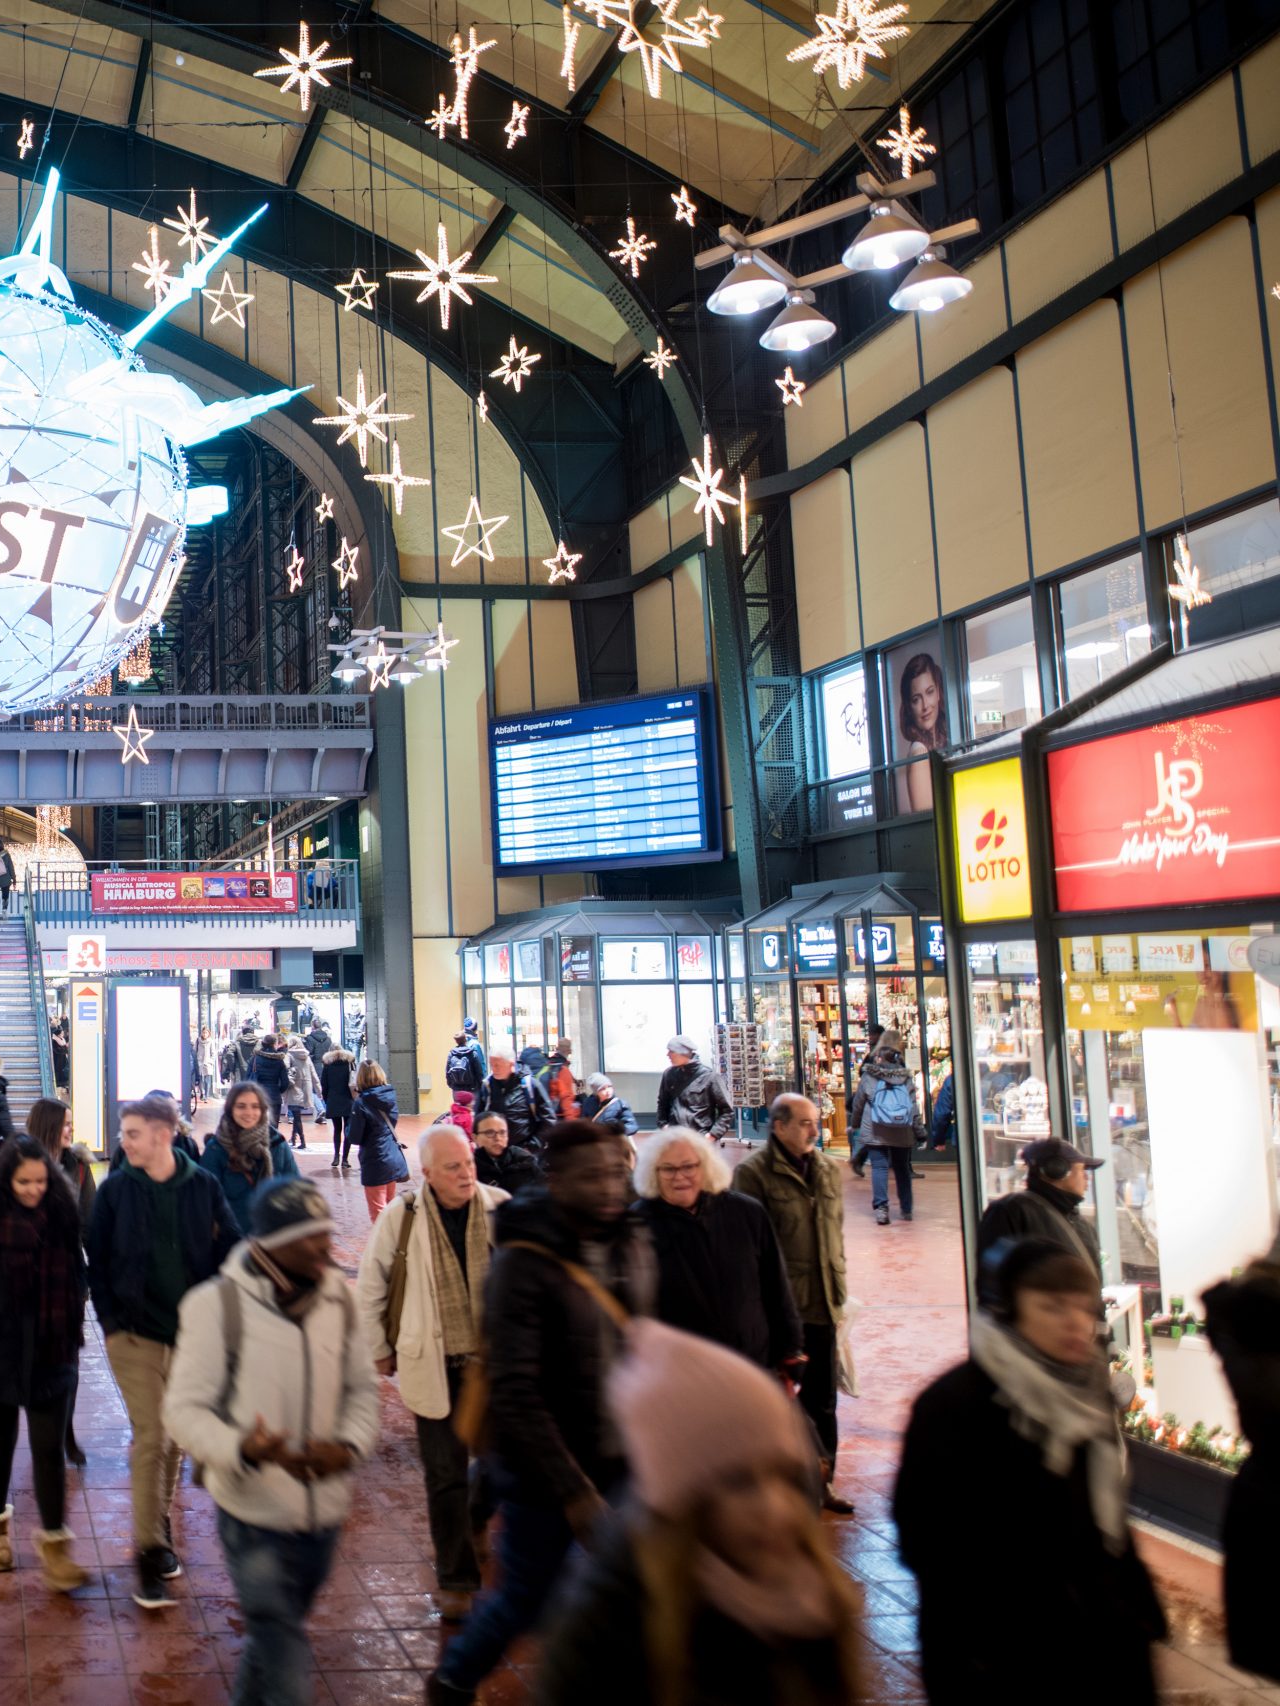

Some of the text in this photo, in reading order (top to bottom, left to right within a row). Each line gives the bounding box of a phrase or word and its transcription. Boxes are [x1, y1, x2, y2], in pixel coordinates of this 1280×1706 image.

[495, 724, 522, 735] Abfahrt
[523, 720, 551, 731] Departure
[1196, 807, 1231, 818] SPECIAL
[1192, 822, 1229, 868] Day
[967, 857, 1021, 883] LOTTO
[103, 888, 177, 900] HAMBURG
[163, 952, 270, 968] ROSSMANN
[78, 1001, 97, 1021] E
